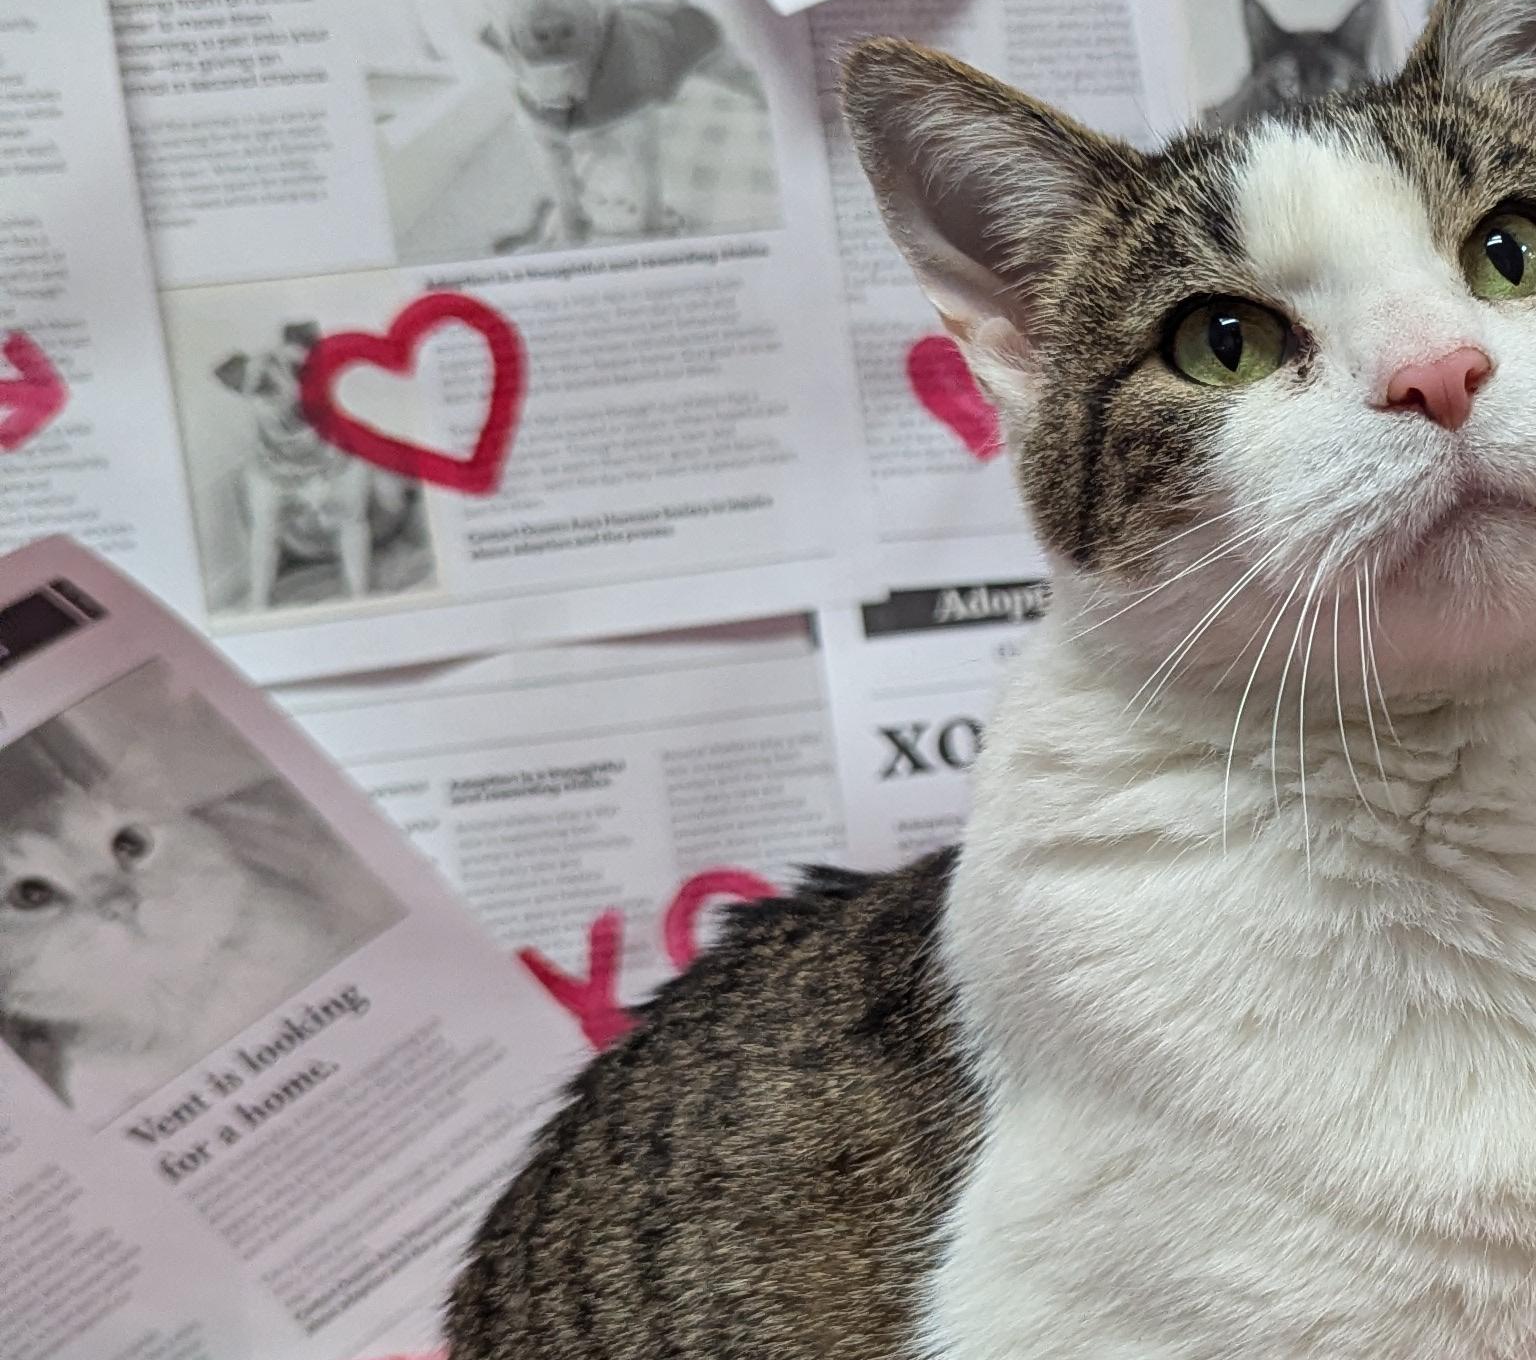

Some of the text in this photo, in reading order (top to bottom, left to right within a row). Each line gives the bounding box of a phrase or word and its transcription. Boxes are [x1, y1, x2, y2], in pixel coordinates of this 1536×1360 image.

[125, 982, 372, 1147] Vent is looking
[158, 1055, 342, 1185] for a home.
